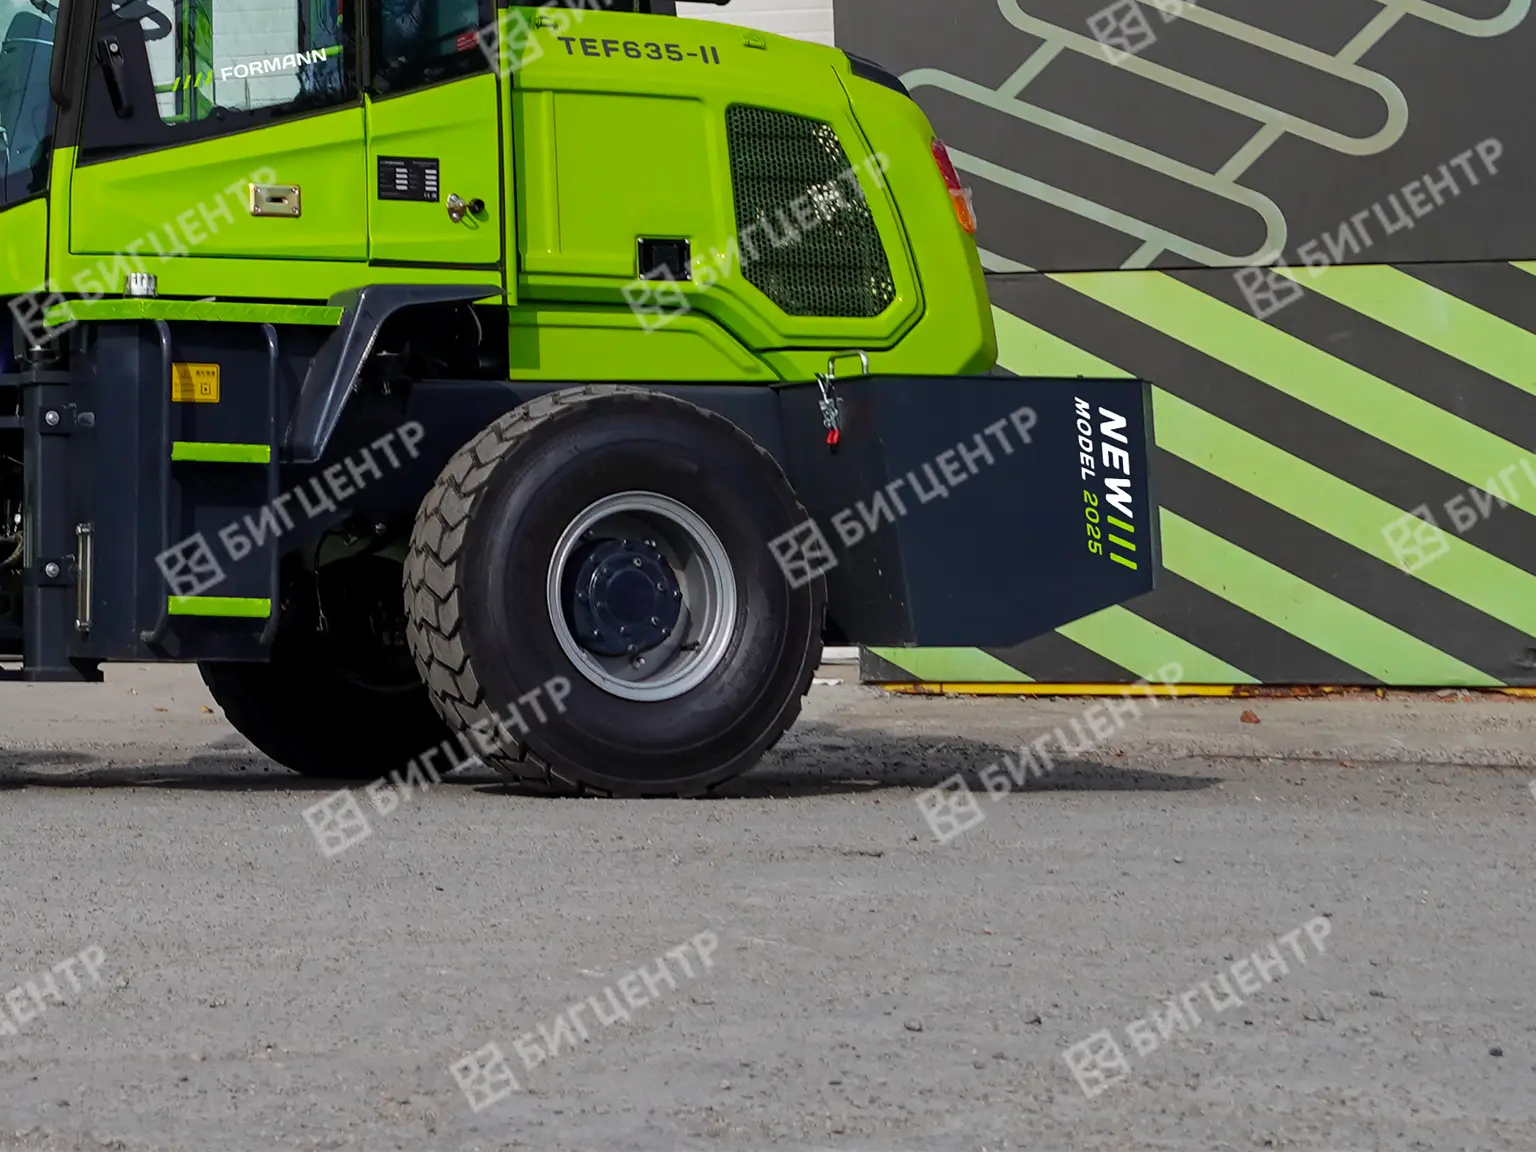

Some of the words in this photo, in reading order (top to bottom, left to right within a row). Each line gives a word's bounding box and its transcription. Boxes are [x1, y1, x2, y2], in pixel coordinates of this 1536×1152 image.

[221, 48, 328, 82] FORMANN
[557, 36, 721, 65] TEF635-II
[1074, 396, 1096, 481] MODEL
[1098, 406, 1134, 519] NEW
[1083, 489, 1103, 556] 2025
